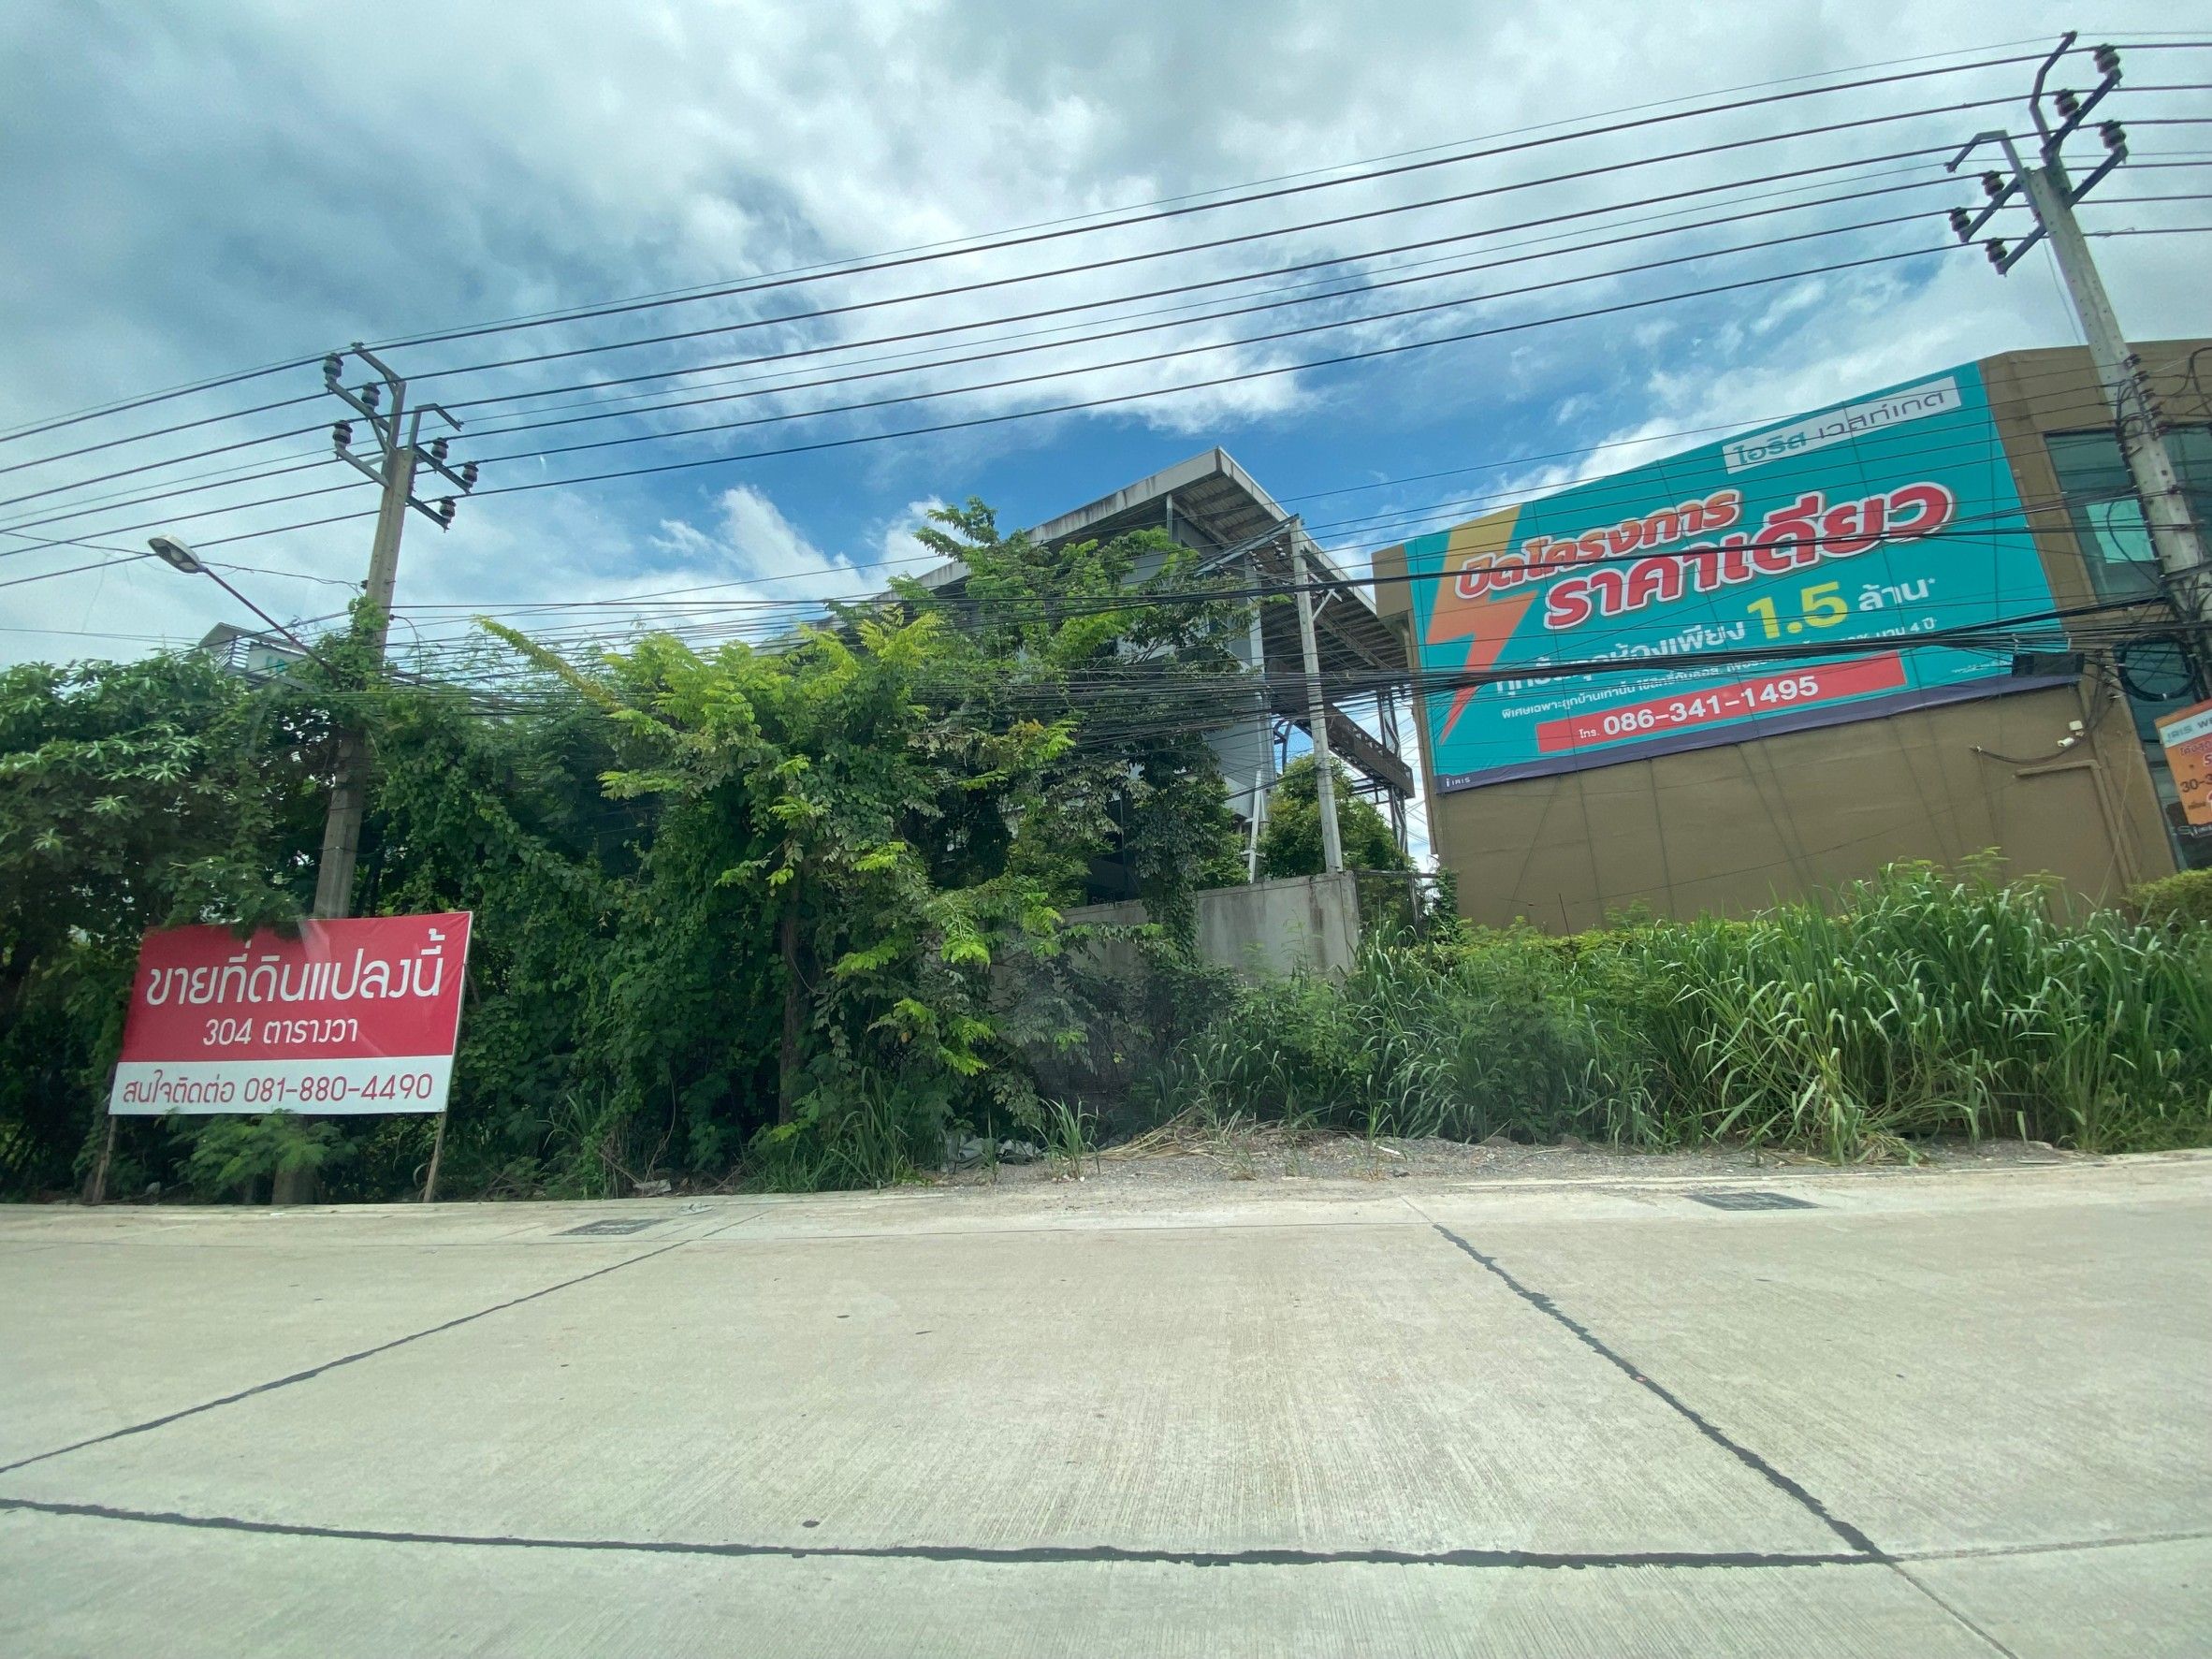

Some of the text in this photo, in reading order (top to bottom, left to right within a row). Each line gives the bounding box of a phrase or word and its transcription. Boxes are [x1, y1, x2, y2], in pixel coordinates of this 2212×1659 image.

[1733, 431, 1808, 466] ไอริส
[1457, 489, 1742, 599] ปิดโครงการ
[1545, 482, 1956, 629] ราคาเดียว
[1747, 581, 1849, 640] 1.5
[1501, 680, 1636, 720] พิเศษเฉพาะลูกบ้านเท่านั้น
[1579, 676, 1819, 740] โทร. 086-341-1495
[146, 928, 445, 1006] ขายที่ดินแปลงนี้
[203, 1017, 359, 1046] 304 ตารางวา
[123, 1069, 434, 1104] สนใจติดต่อ 081-880-4490
